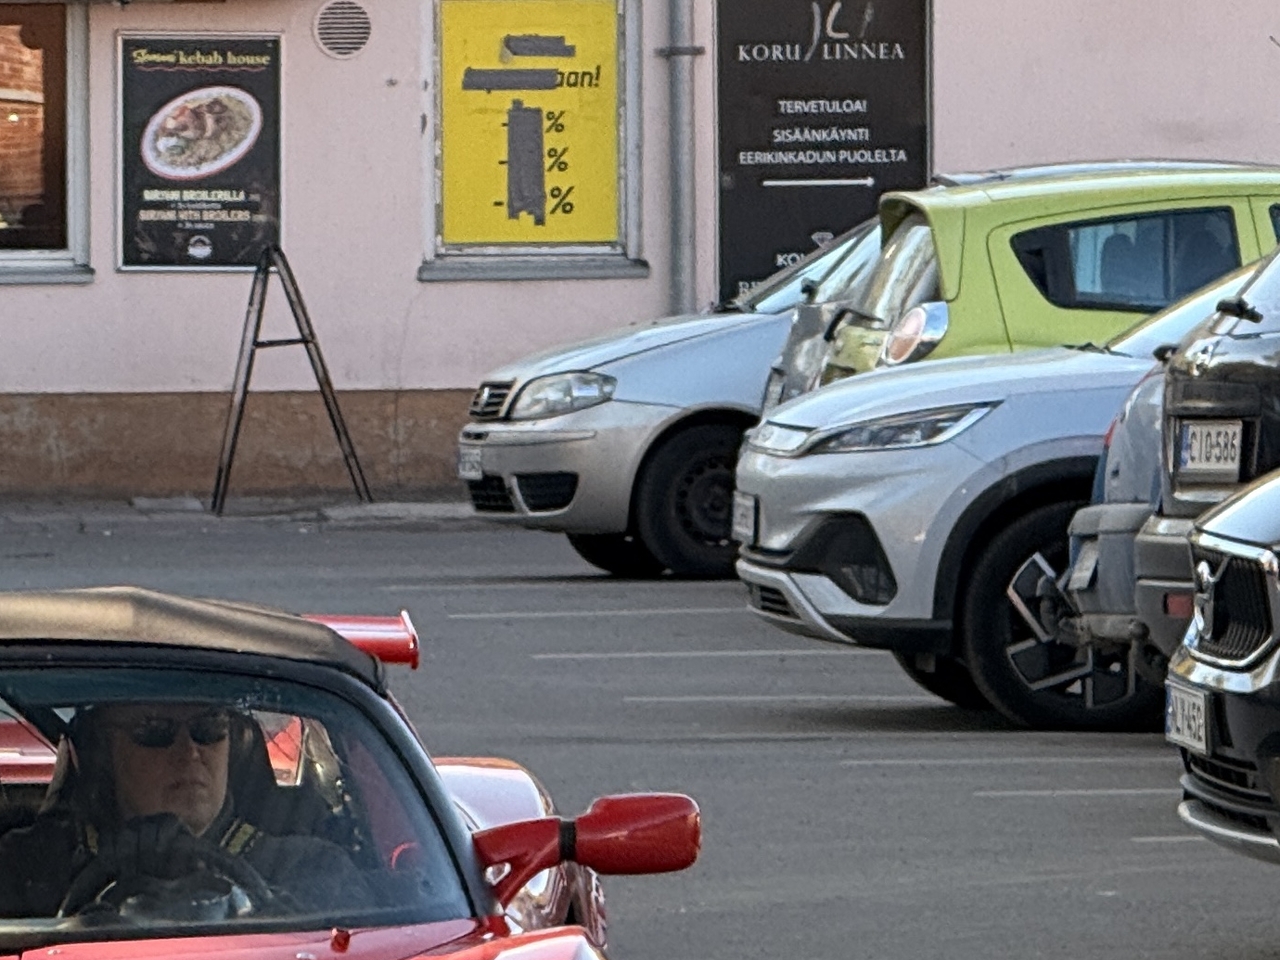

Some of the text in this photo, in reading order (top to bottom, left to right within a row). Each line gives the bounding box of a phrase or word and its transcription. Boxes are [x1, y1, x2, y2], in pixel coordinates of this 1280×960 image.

[179, 50, 224, 65] kebab
[226, 50, 271, 65] house
[738, 42, 906, 62] KORU LINNEA
[777, 99, 868, 114] TERVETULOA!
[772, 127, 870, 143] SISÄÄNKÄYNTI
[738, 149, 908, 165] EERIKINKADUN PUOLELTA
